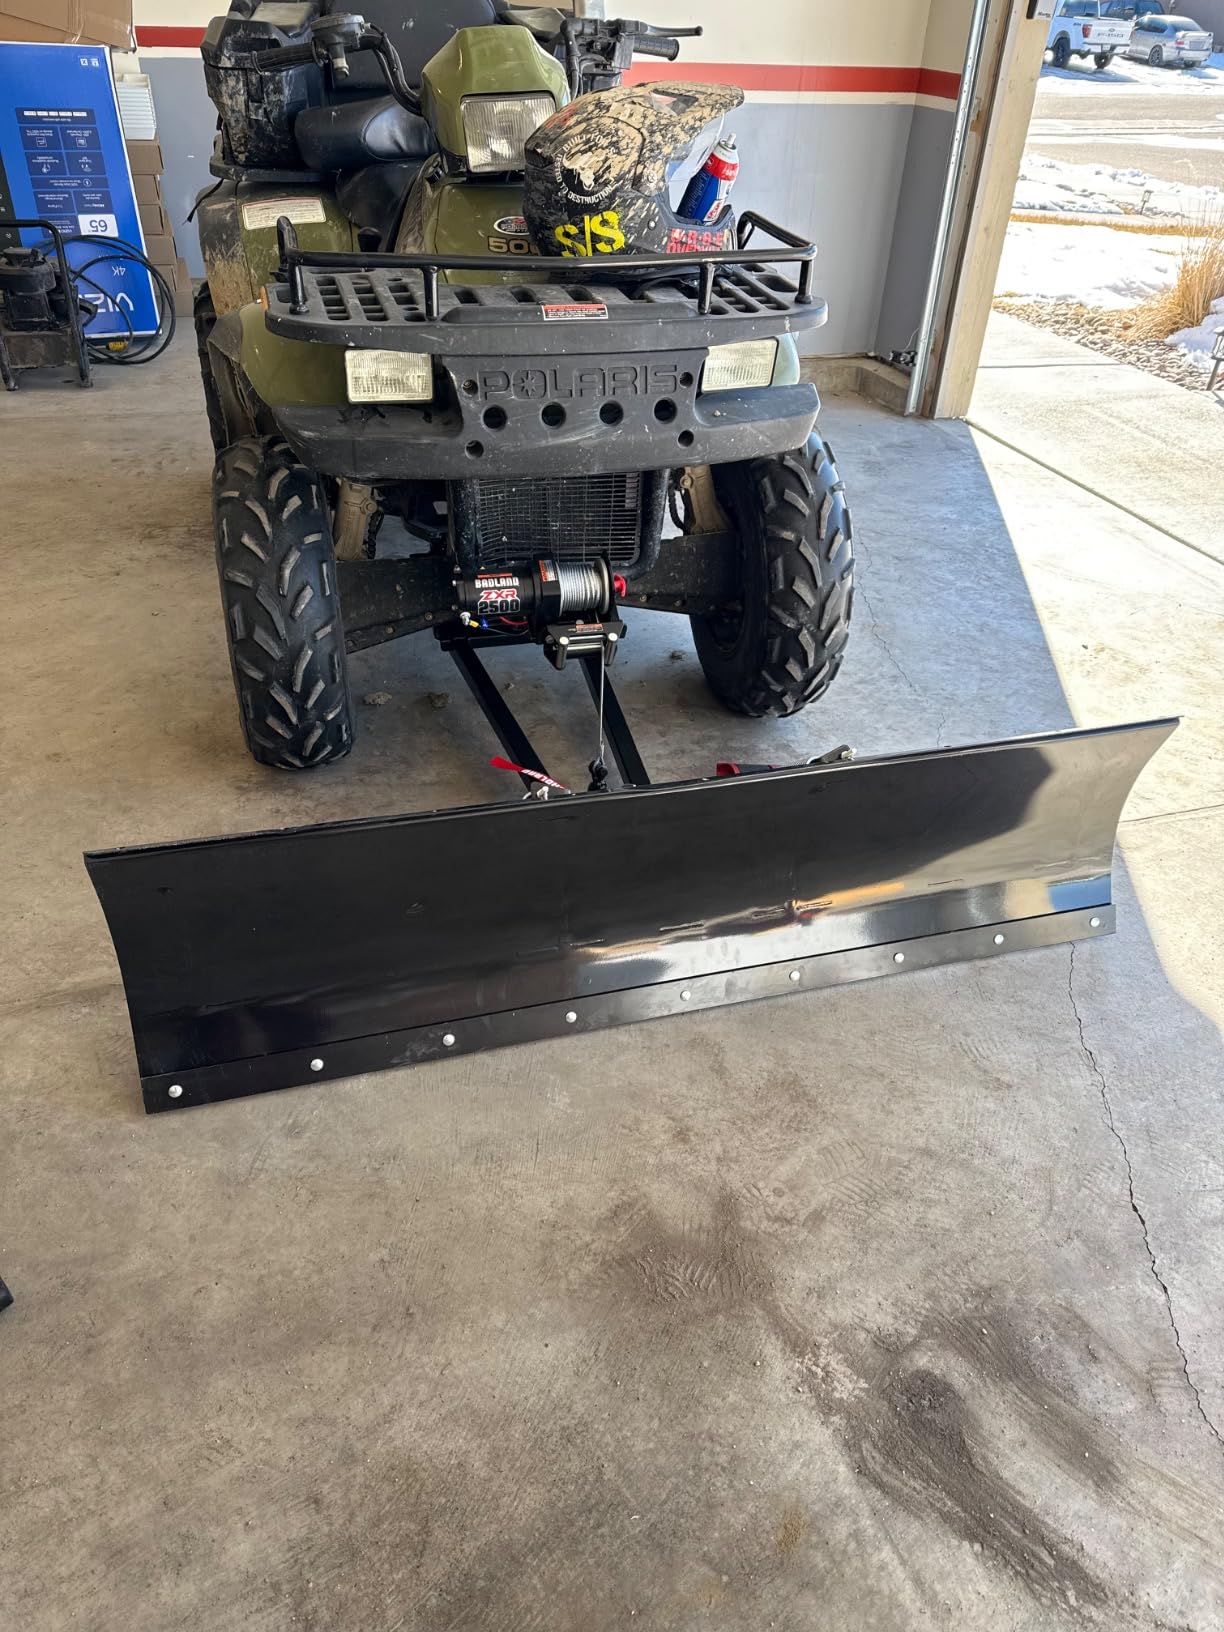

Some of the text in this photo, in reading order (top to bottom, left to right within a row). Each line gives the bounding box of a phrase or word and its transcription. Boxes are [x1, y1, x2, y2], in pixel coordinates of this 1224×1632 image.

[559, 182, 569, 195] TO
[567, 185, 613, 204] DESTRUCTION
[112, 266, 126, 276] 4K
[77, 293, 135, 314] VIZ
[477, 364, 678, 401] POLARIS
[474, 576, 520, 589] BADLAND
[480, 588, 518, 601] ZXR
[478, 599, 520, 615] 2500
